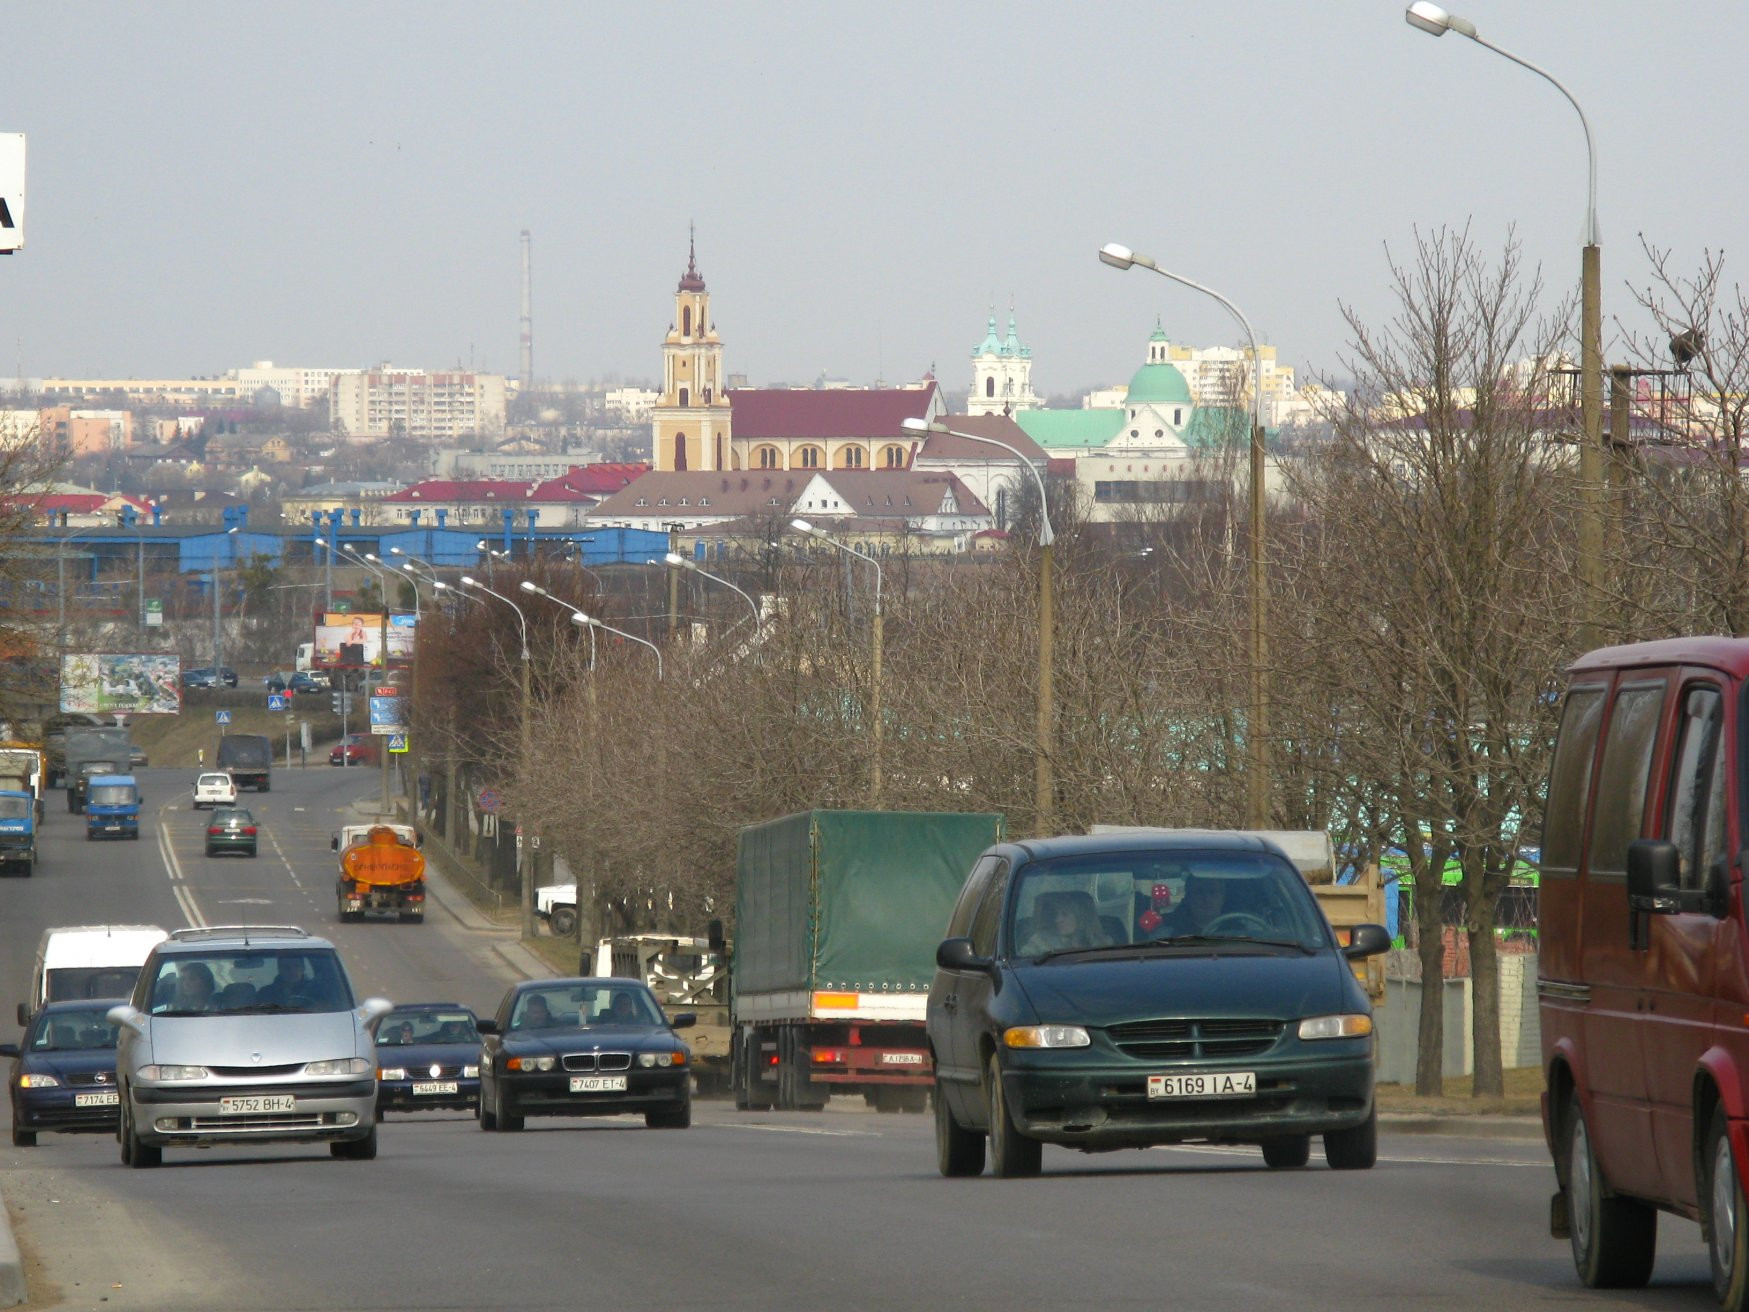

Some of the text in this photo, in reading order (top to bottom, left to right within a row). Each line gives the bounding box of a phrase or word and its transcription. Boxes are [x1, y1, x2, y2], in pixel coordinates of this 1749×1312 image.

[579, 1079, 600, 1089] 7407
[602, 1079, 625, 1089] ET-4
[1164, 1077, 1205, 1095] 6169
[84, 1095, 104, 1105] 7174
[232, 1099, 260, 1112] 5752
[262, 1098, 292, 1111] BH-4
